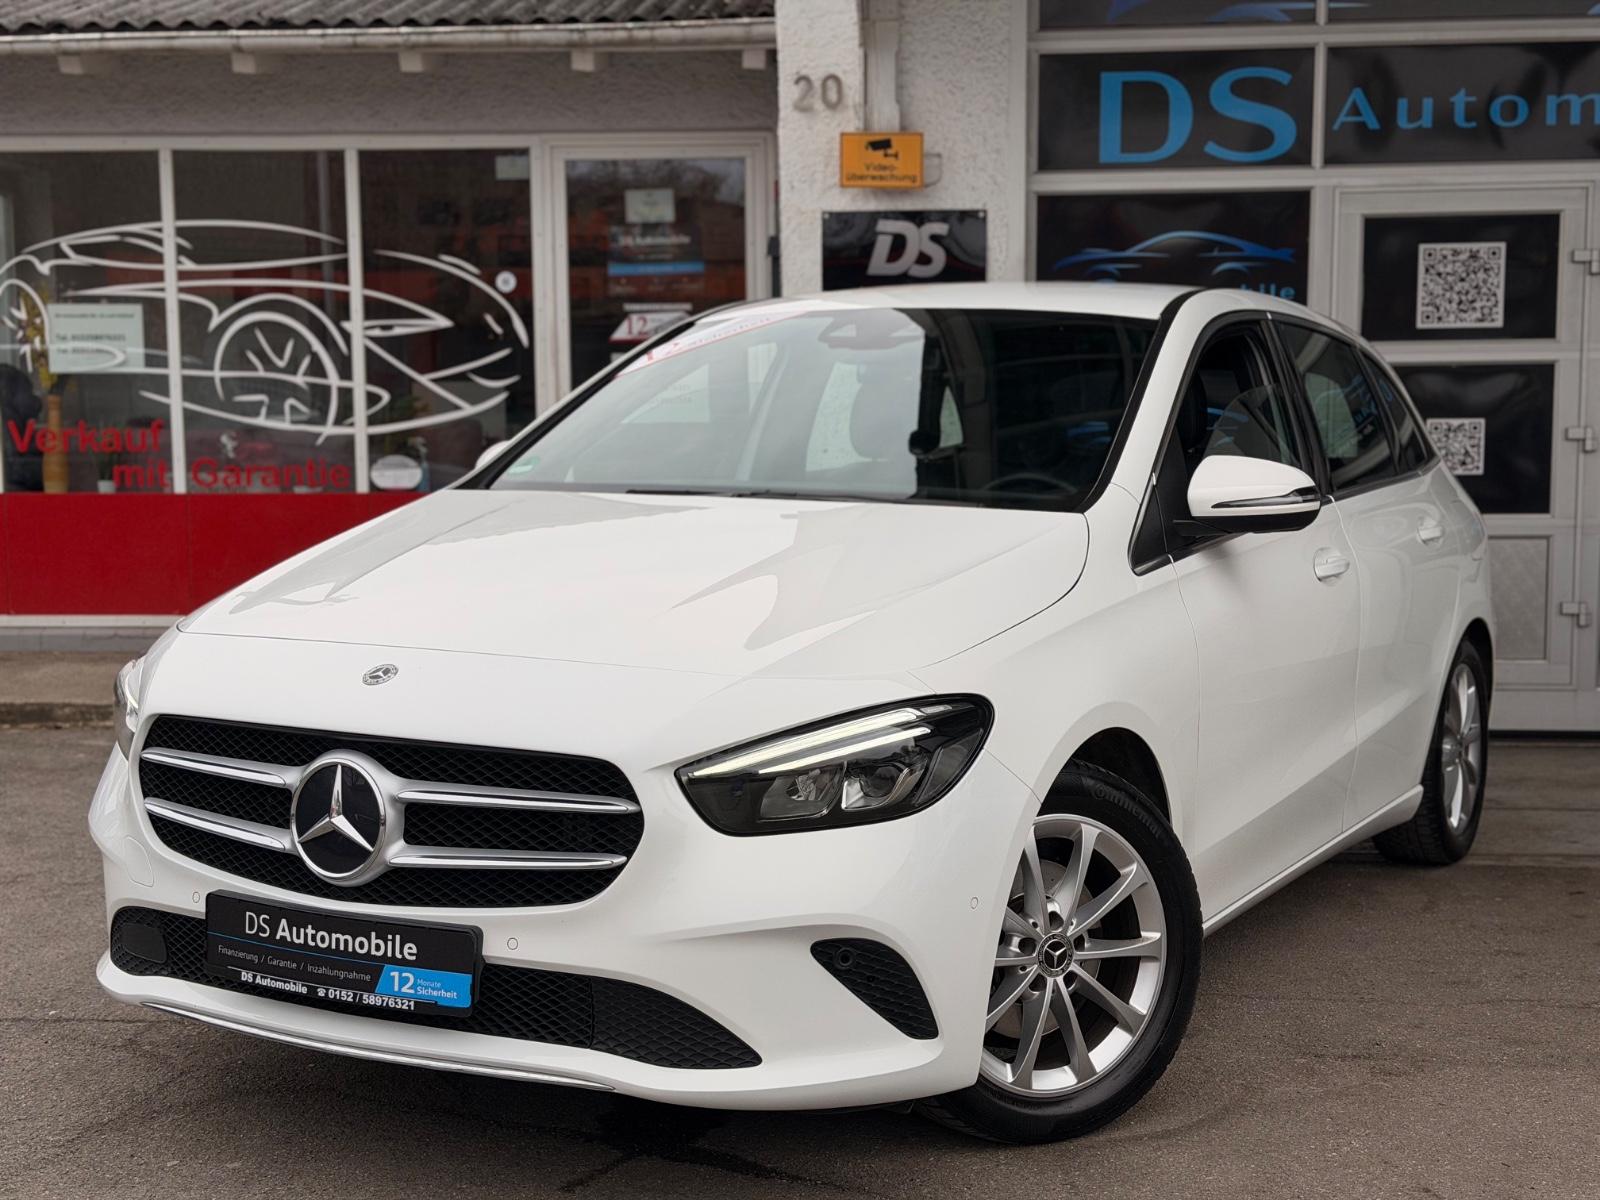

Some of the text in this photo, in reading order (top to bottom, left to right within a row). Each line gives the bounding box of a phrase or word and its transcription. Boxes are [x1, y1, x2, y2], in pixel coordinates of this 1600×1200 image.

[794, 74, 843, 112] 20
[1099, 67, 1600, 163] DS Autom
[866, 219, 949, 278] DS
[7, 419, 164, 453] Verkauf
[113, 458, 350, 488] mit Garantie
[245, 911, 418, 960] DS Automobile
[218, 945, 258, 963] Finanzierung
[267, 955, 297, 970] Garantie
[307, 963, 371, 982] Inzahlungnahme
[241, 971, 253, 983] DS
[255, 976, 308, 994] Automobile
[328, 988, 354, 1002] 0152
[362, 994, 415, 1011] 58976321
[389, 971, 415, 994] 12
[416, 986, 458, 999] Sicherheit
